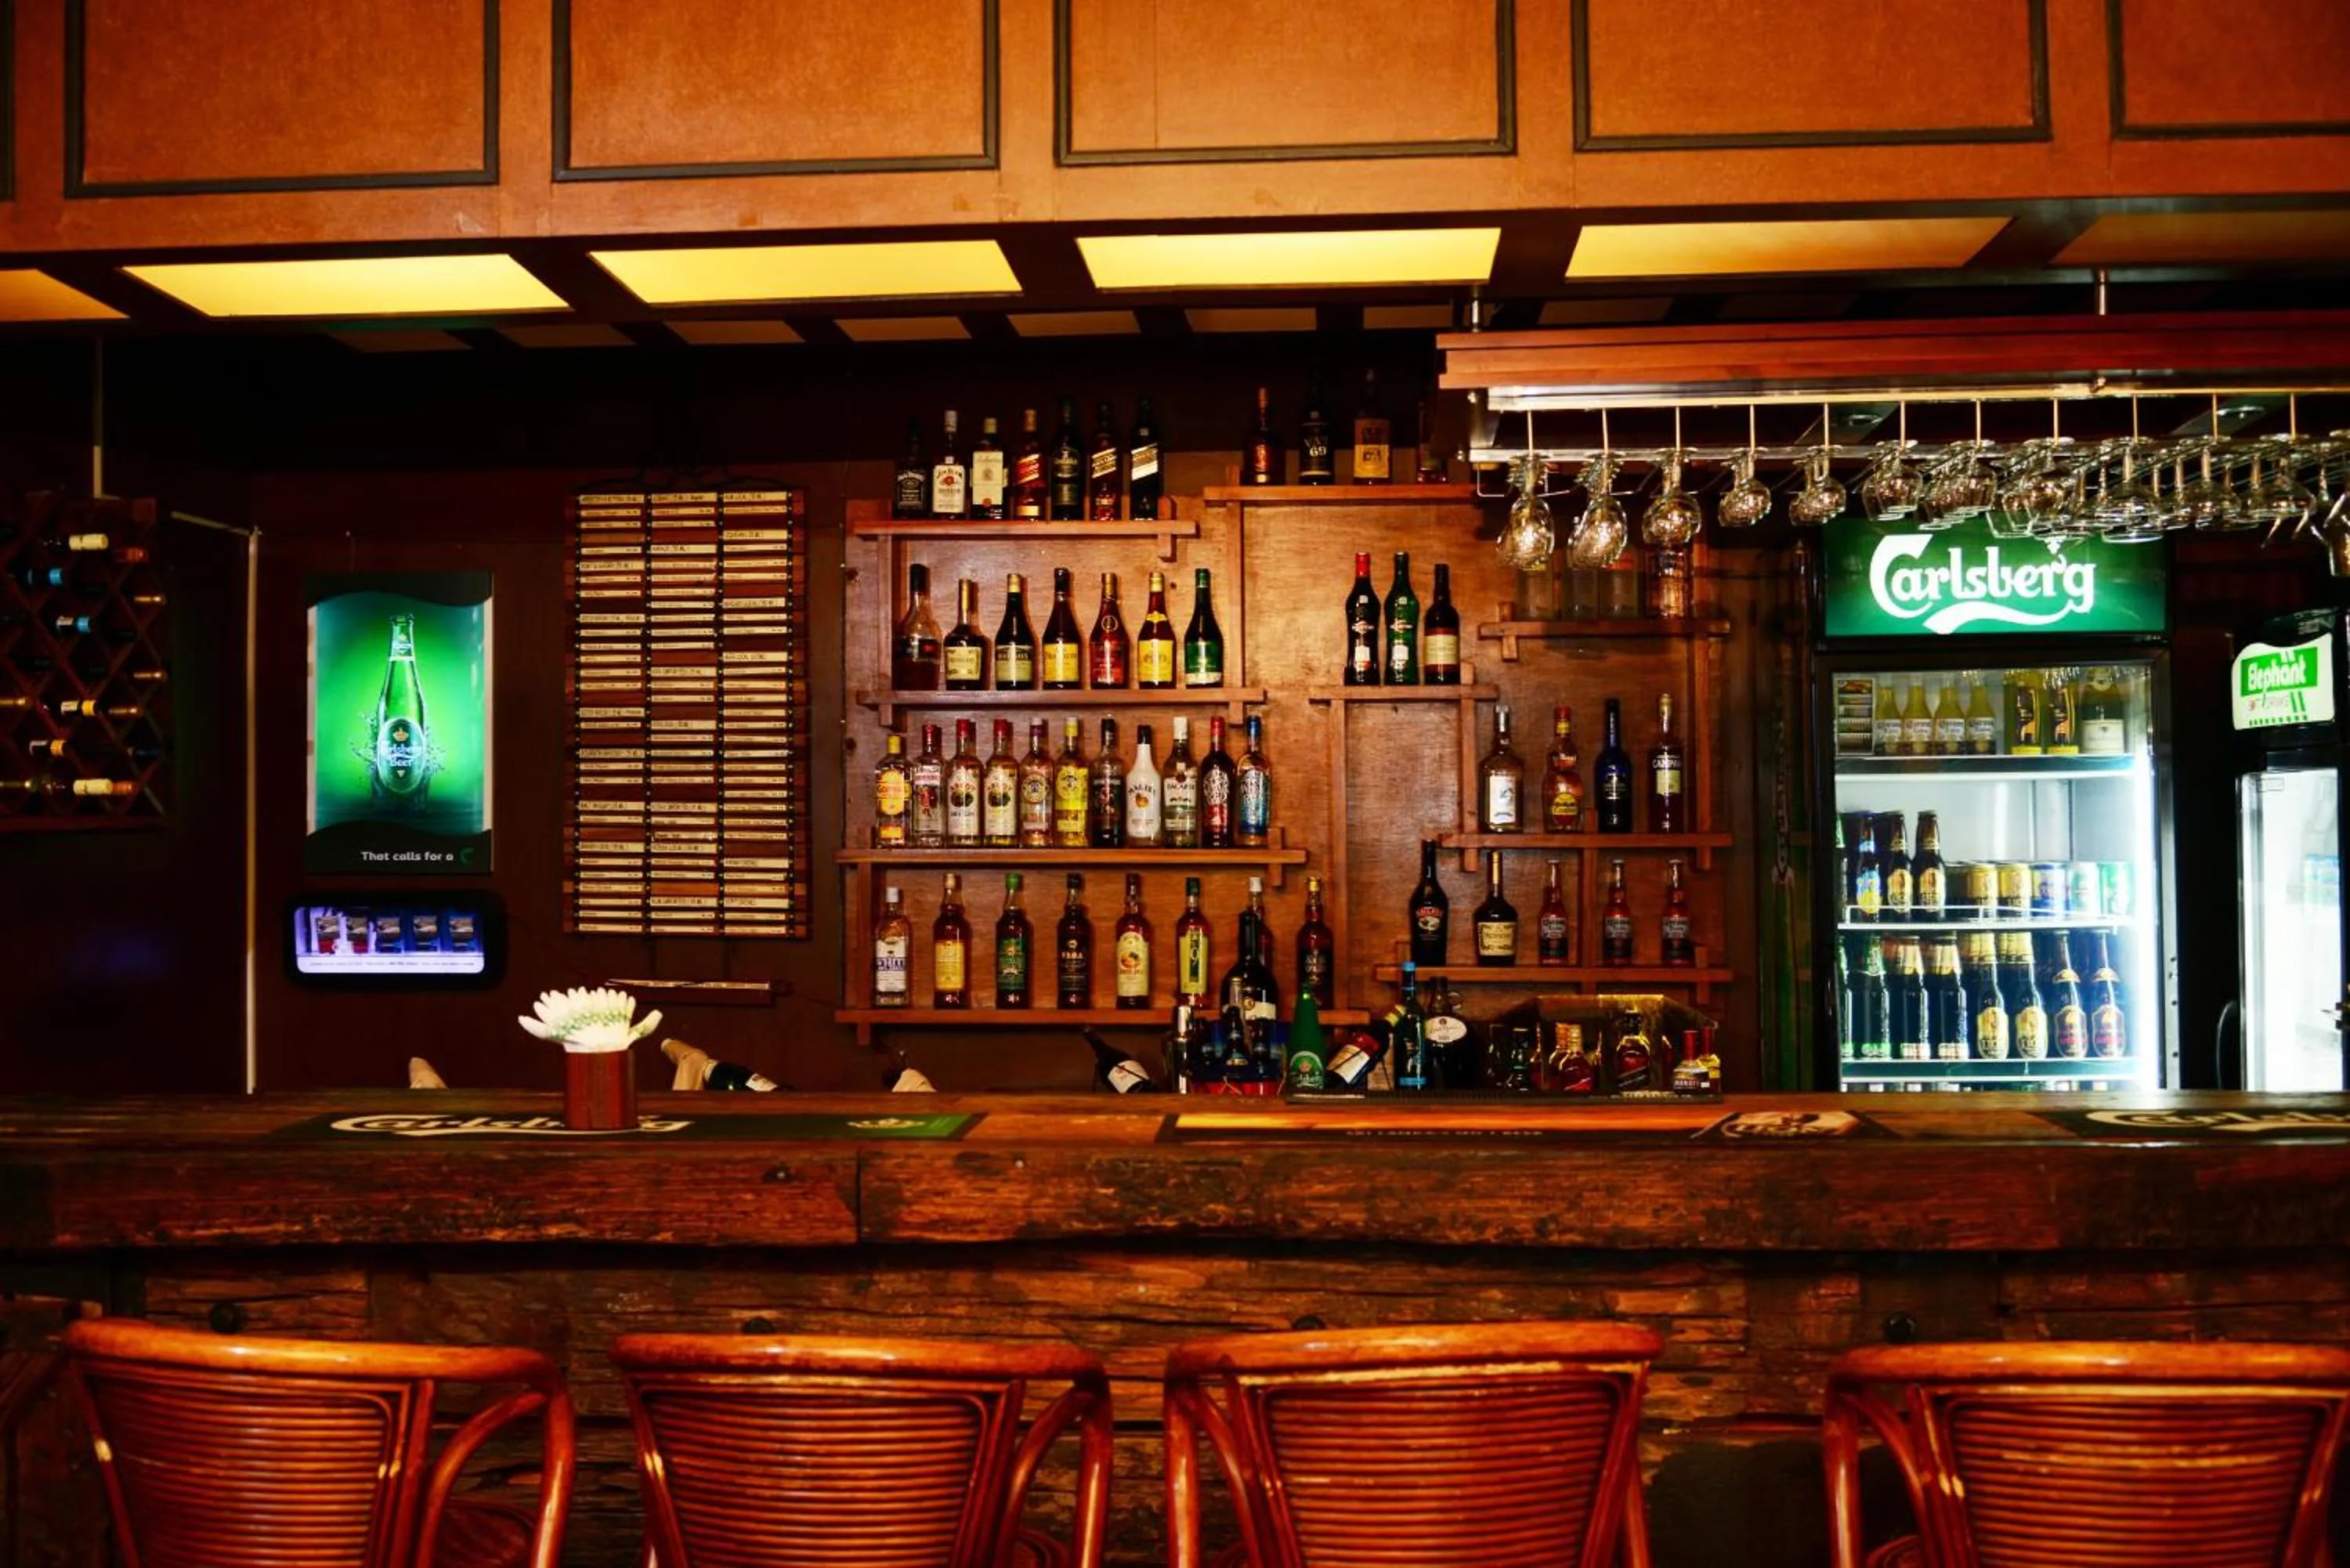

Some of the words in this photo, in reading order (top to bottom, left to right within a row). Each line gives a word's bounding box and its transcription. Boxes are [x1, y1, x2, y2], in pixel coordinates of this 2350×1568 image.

[1870, 533, 2096, 620] Carlsberg
[360, 851, 390, 861] That
[392, 851, 421, 861] calls
[424, 851, 443, 861] for
[330, 1114, 696, 1136] Carlsbg
